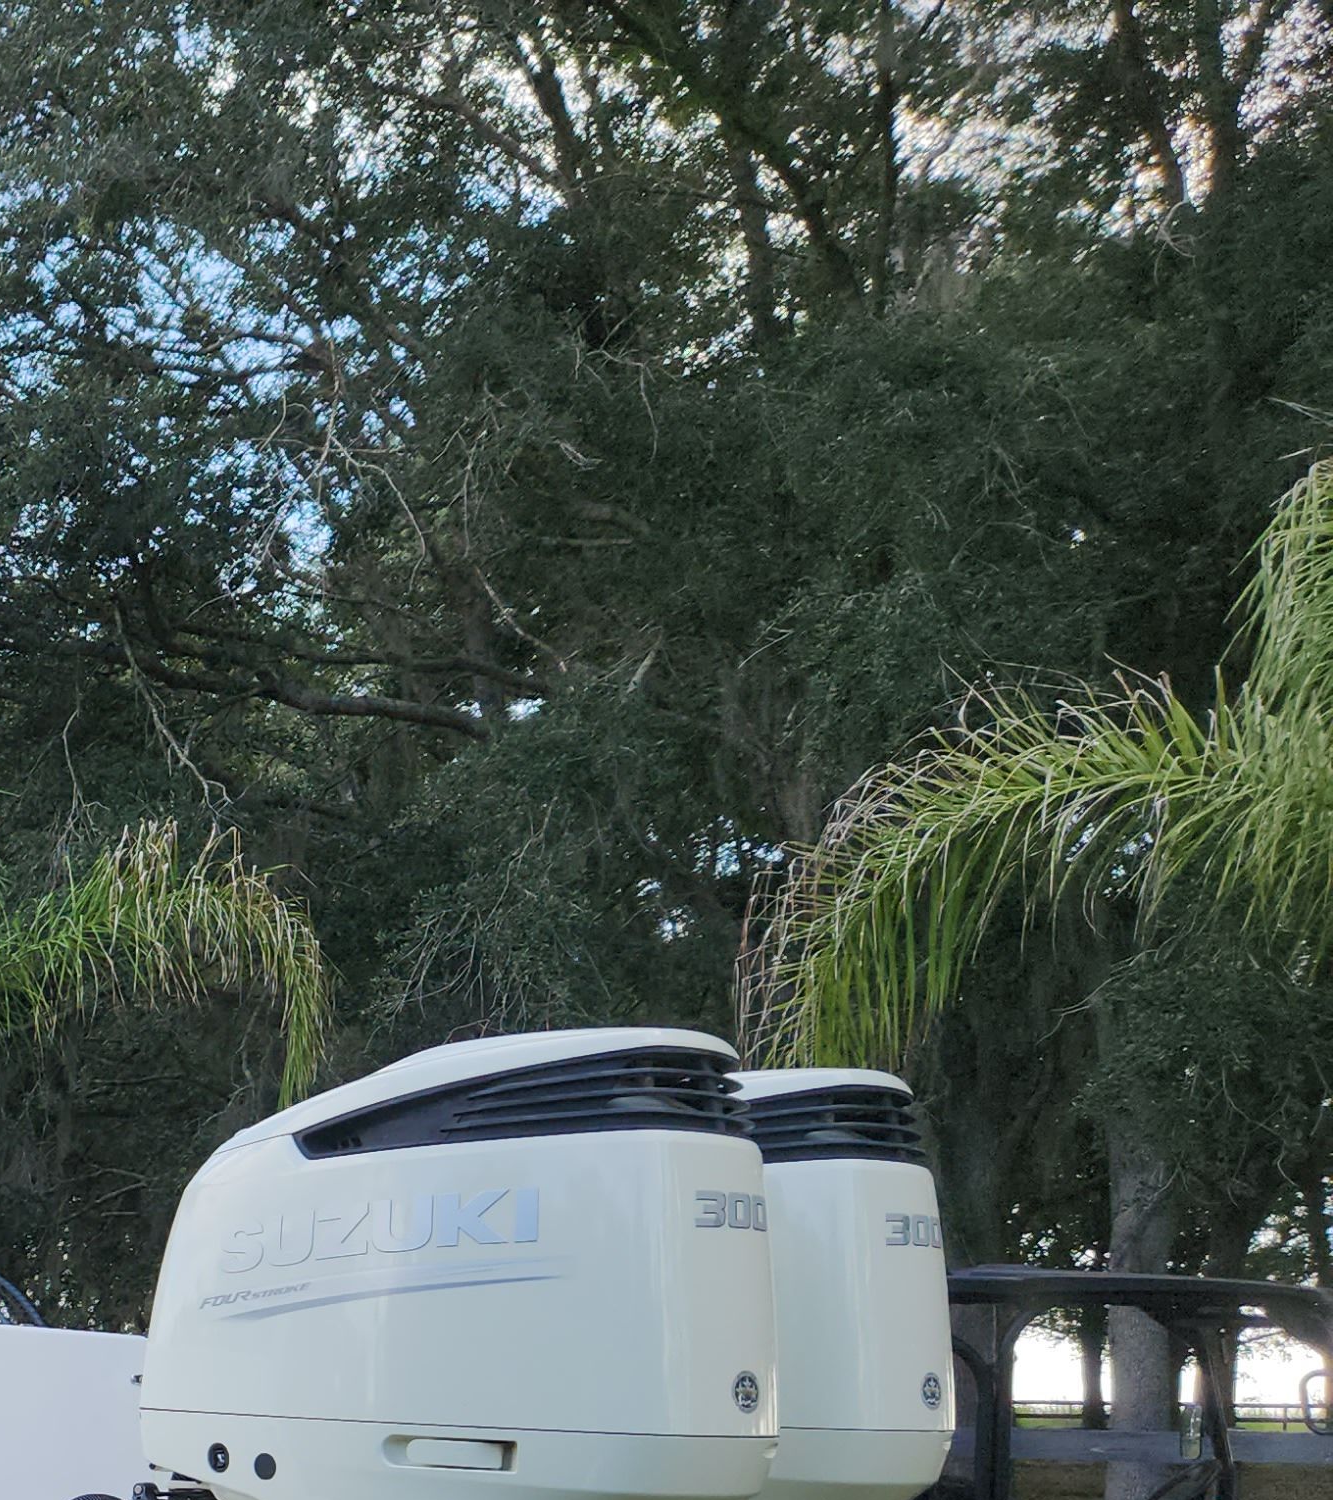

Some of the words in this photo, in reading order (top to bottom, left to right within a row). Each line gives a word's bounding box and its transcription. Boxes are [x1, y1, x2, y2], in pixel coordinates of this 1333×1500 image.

[221, 1187, 540, 1274] SUZUKI
[694, 1190, 768, 1232] 300
[885, 1213, 942, 1249] 300
